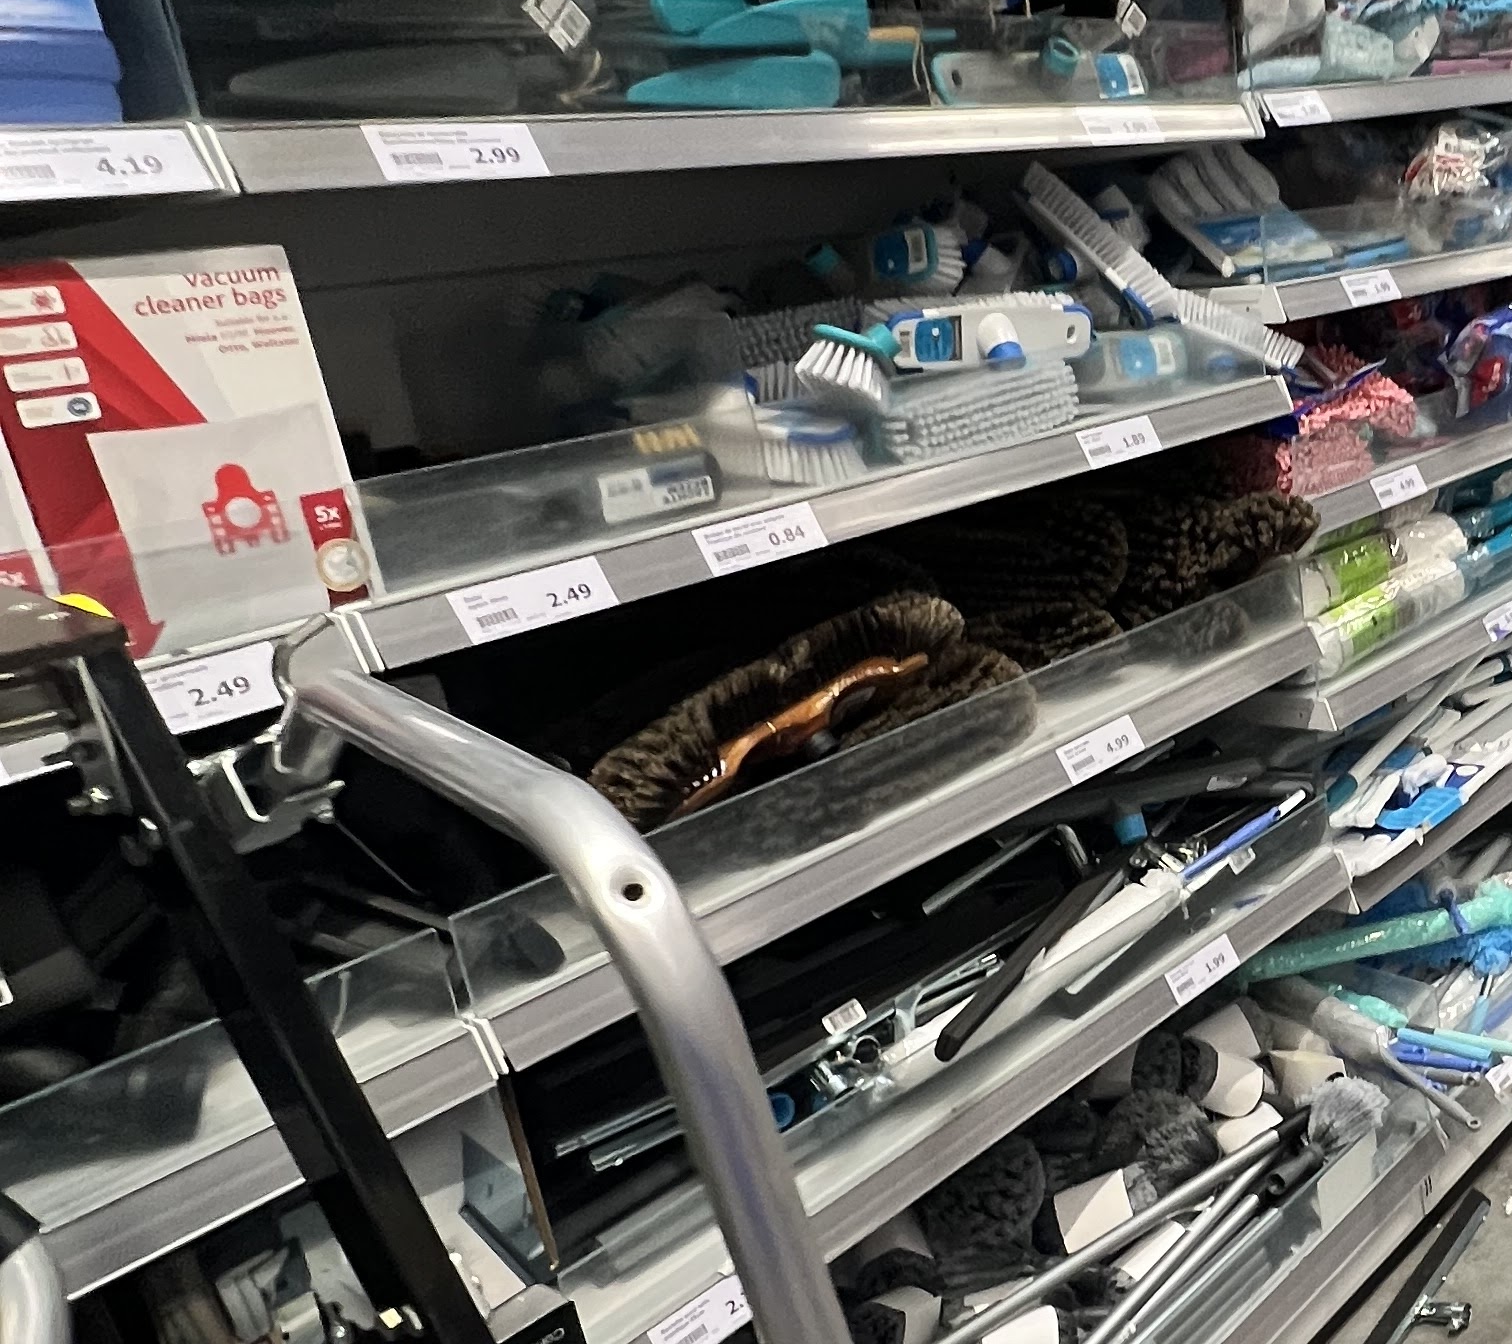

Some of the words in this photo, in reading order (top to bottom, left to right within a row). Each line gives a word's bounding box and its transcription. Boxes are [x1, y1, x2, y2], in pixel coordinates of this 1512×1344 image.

[97, 154, 163, 176] 4.19
[469, 146, 521, 164] 2.99
[134, 294, 225, 317] cleaner
[231, 286, 288, 310] bags
[314, 505, 341, 524] 5x
[768, 525, 806, 547] 0.84
[546, 583, 592, 608] 2.49
[187, 675, 251, 706] 2.49
